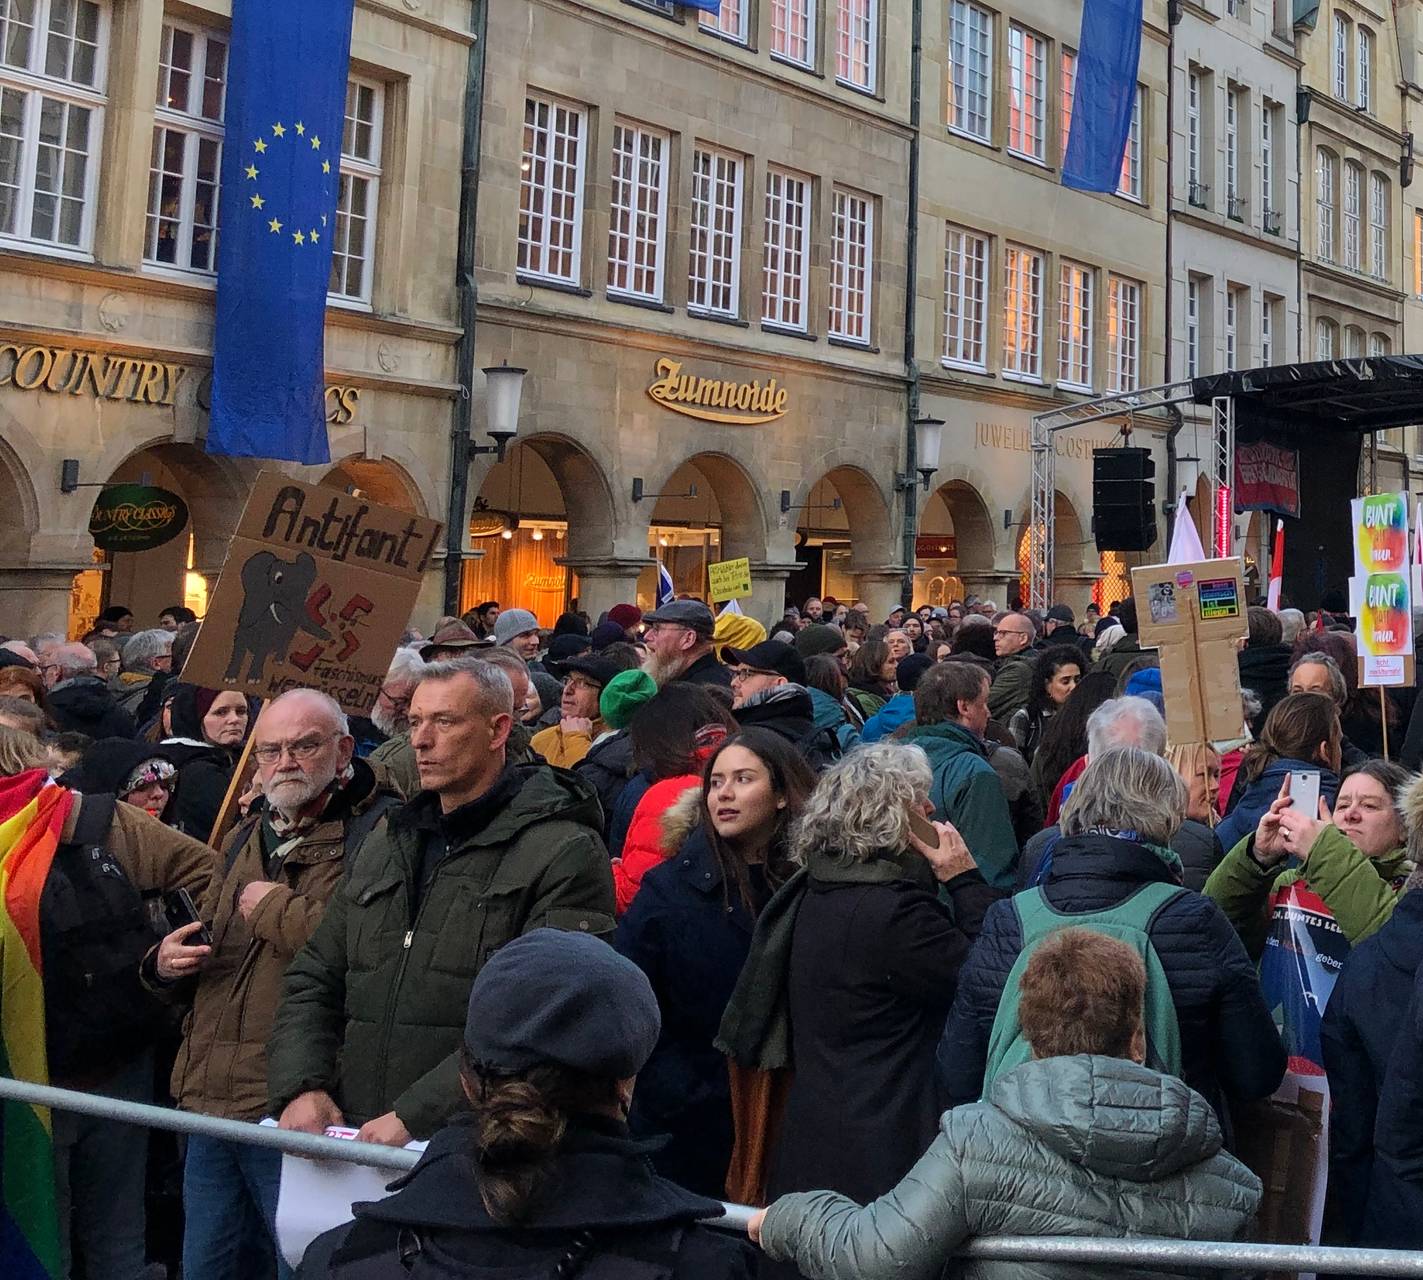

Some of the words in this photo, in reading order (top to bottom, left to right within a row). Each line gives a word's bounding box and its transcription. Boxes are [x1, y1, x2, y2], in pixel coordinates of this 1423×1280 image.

[0, 344, 189, 404] COUNTRY
[649, 358, 790, 418] Zumnorde
[262, 485, 443, 572] Antifant!
[1366, 503, 1397, 528] BUNT
